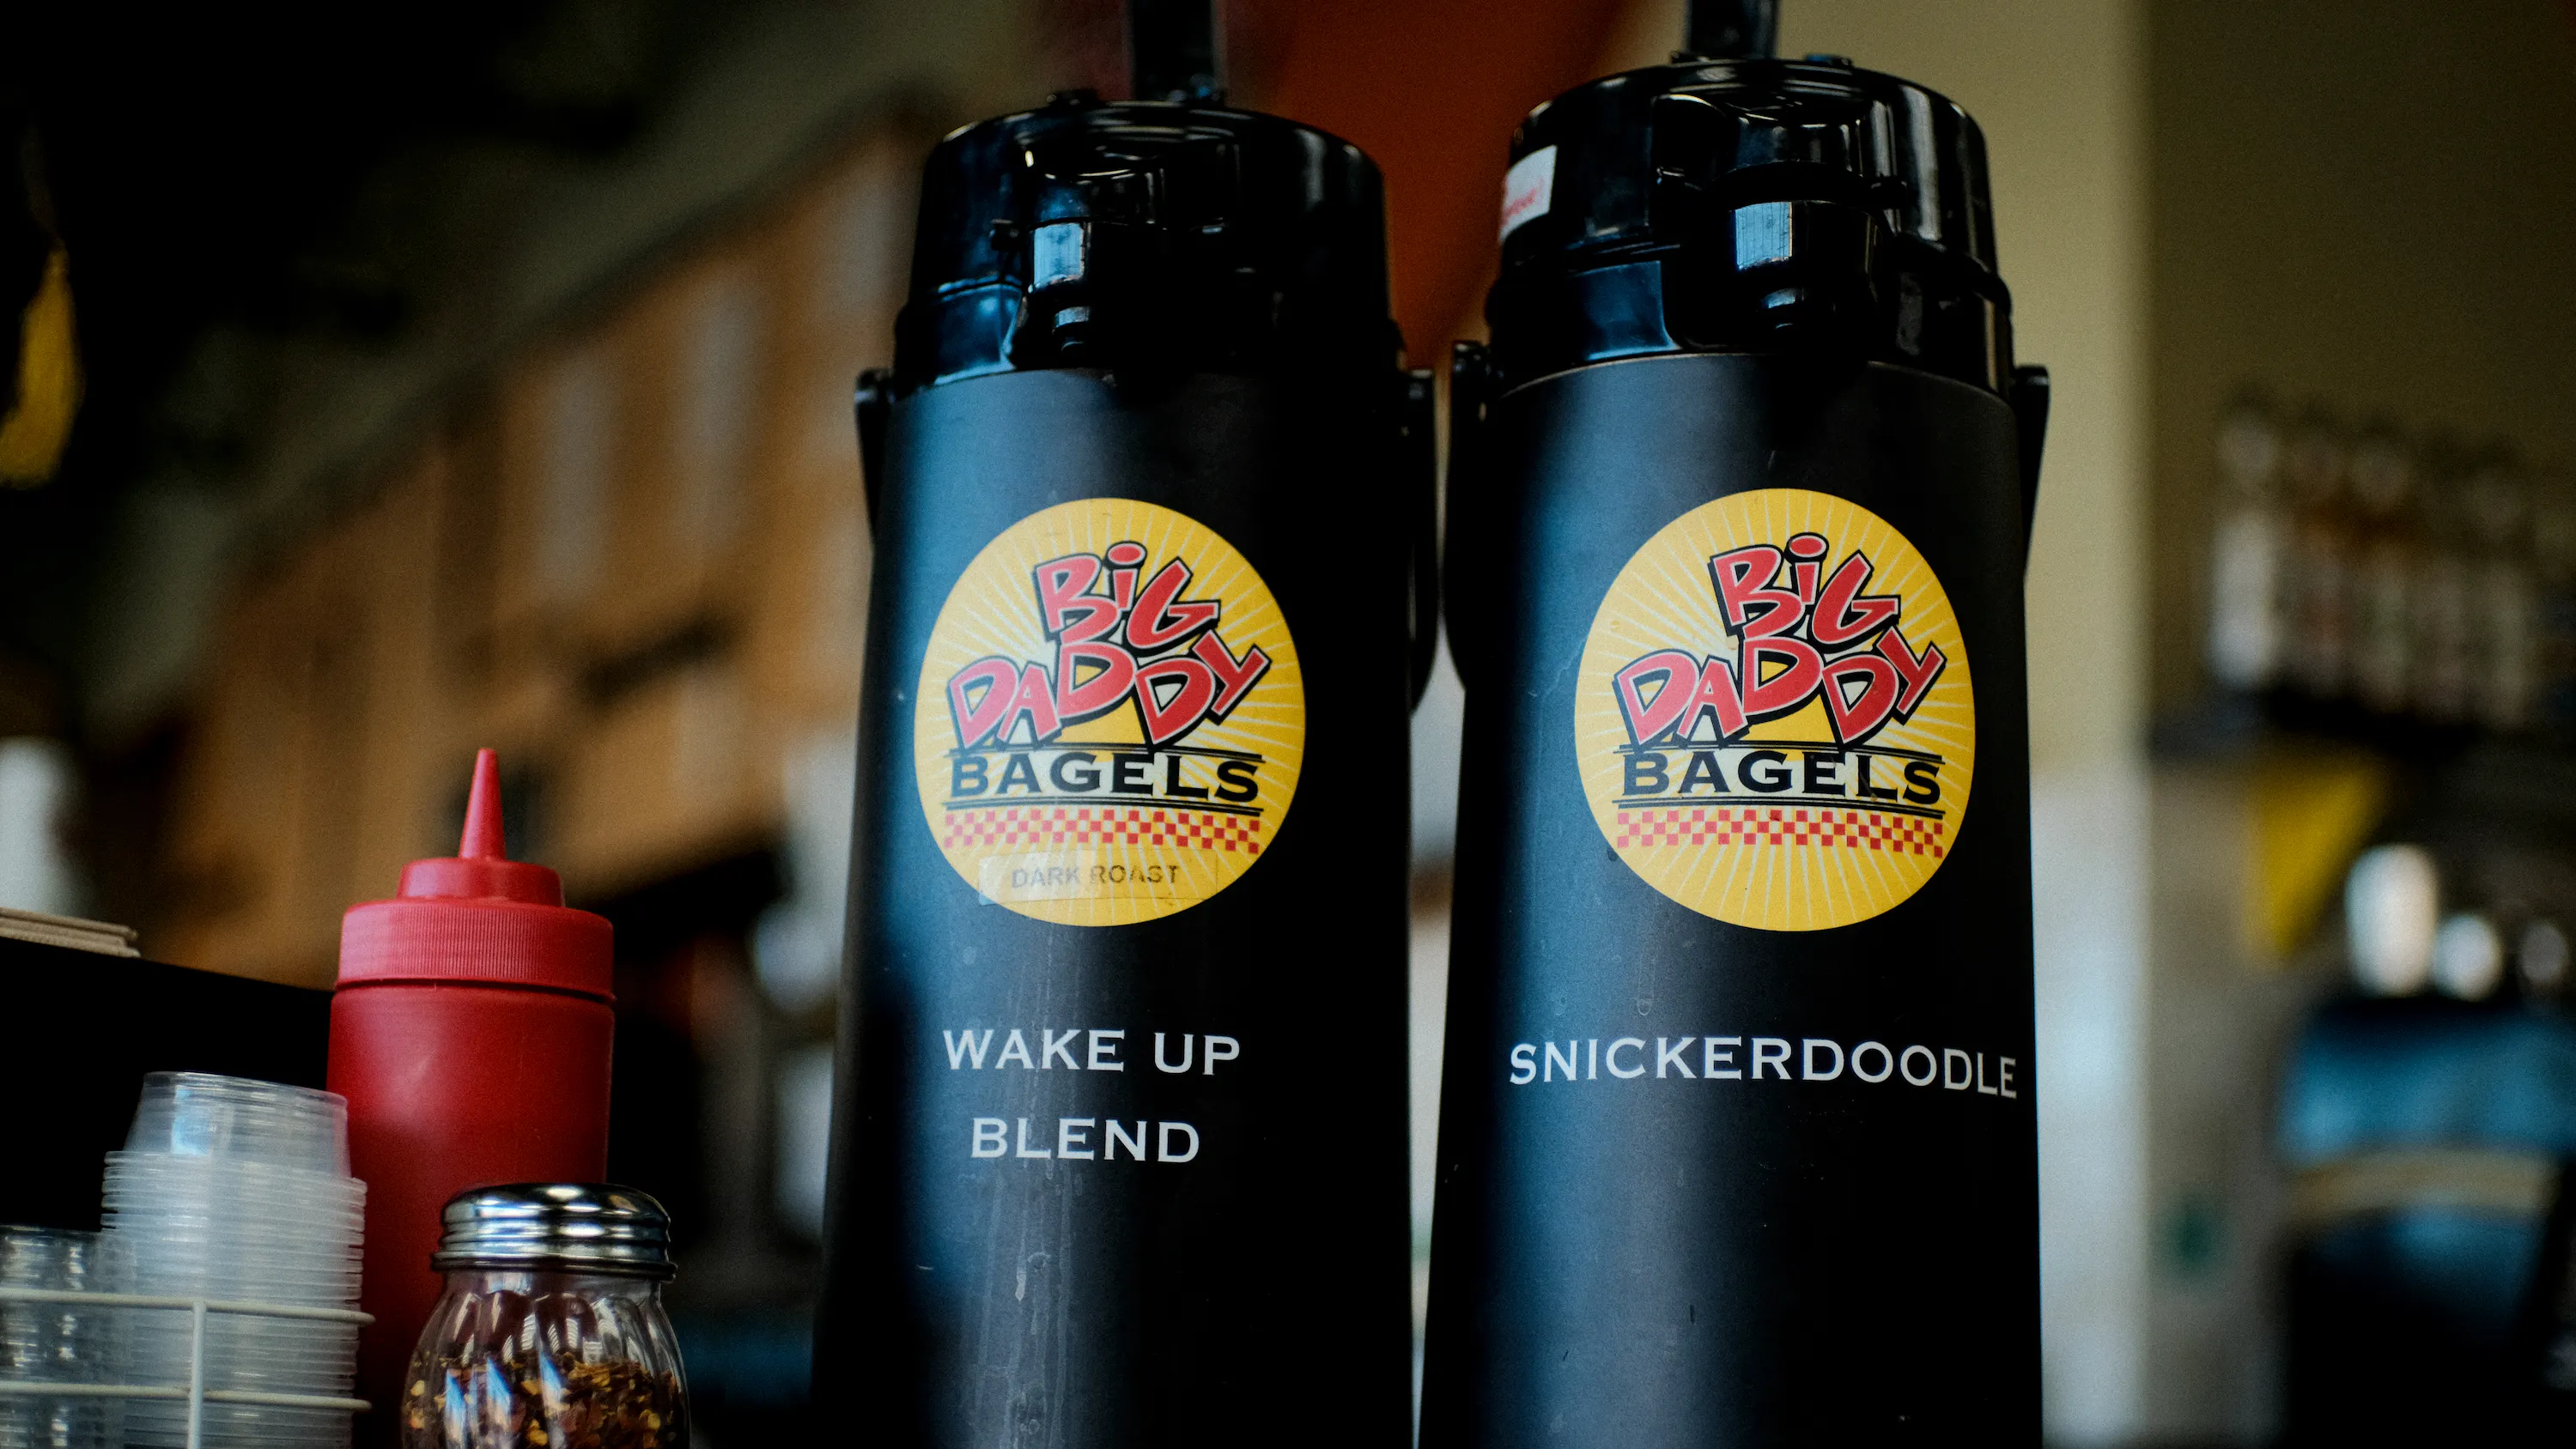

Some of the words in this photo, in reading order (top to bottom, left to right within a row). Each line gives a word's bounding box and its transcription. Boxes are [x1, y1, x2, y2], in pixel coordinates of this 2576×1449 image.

[945, 629, 1273, 752] DADDY
[1612, 626, 1947, 751] DADDY
[950, 751, 1260, 803] BAGELS
[1622, 749, 1943, 805] BAGELS
[1012, 865, 1080, 888] DARK
[1090, 864, 1181, 885] ROAST
[942, 1029, 1126, 1072] WAKE
[1154, 1032, 1241, 1076] UP
[1509, 1035, 2018, 1100] SNICKERDOODLE
[970, 1117, 1200, 1163] BLEND
